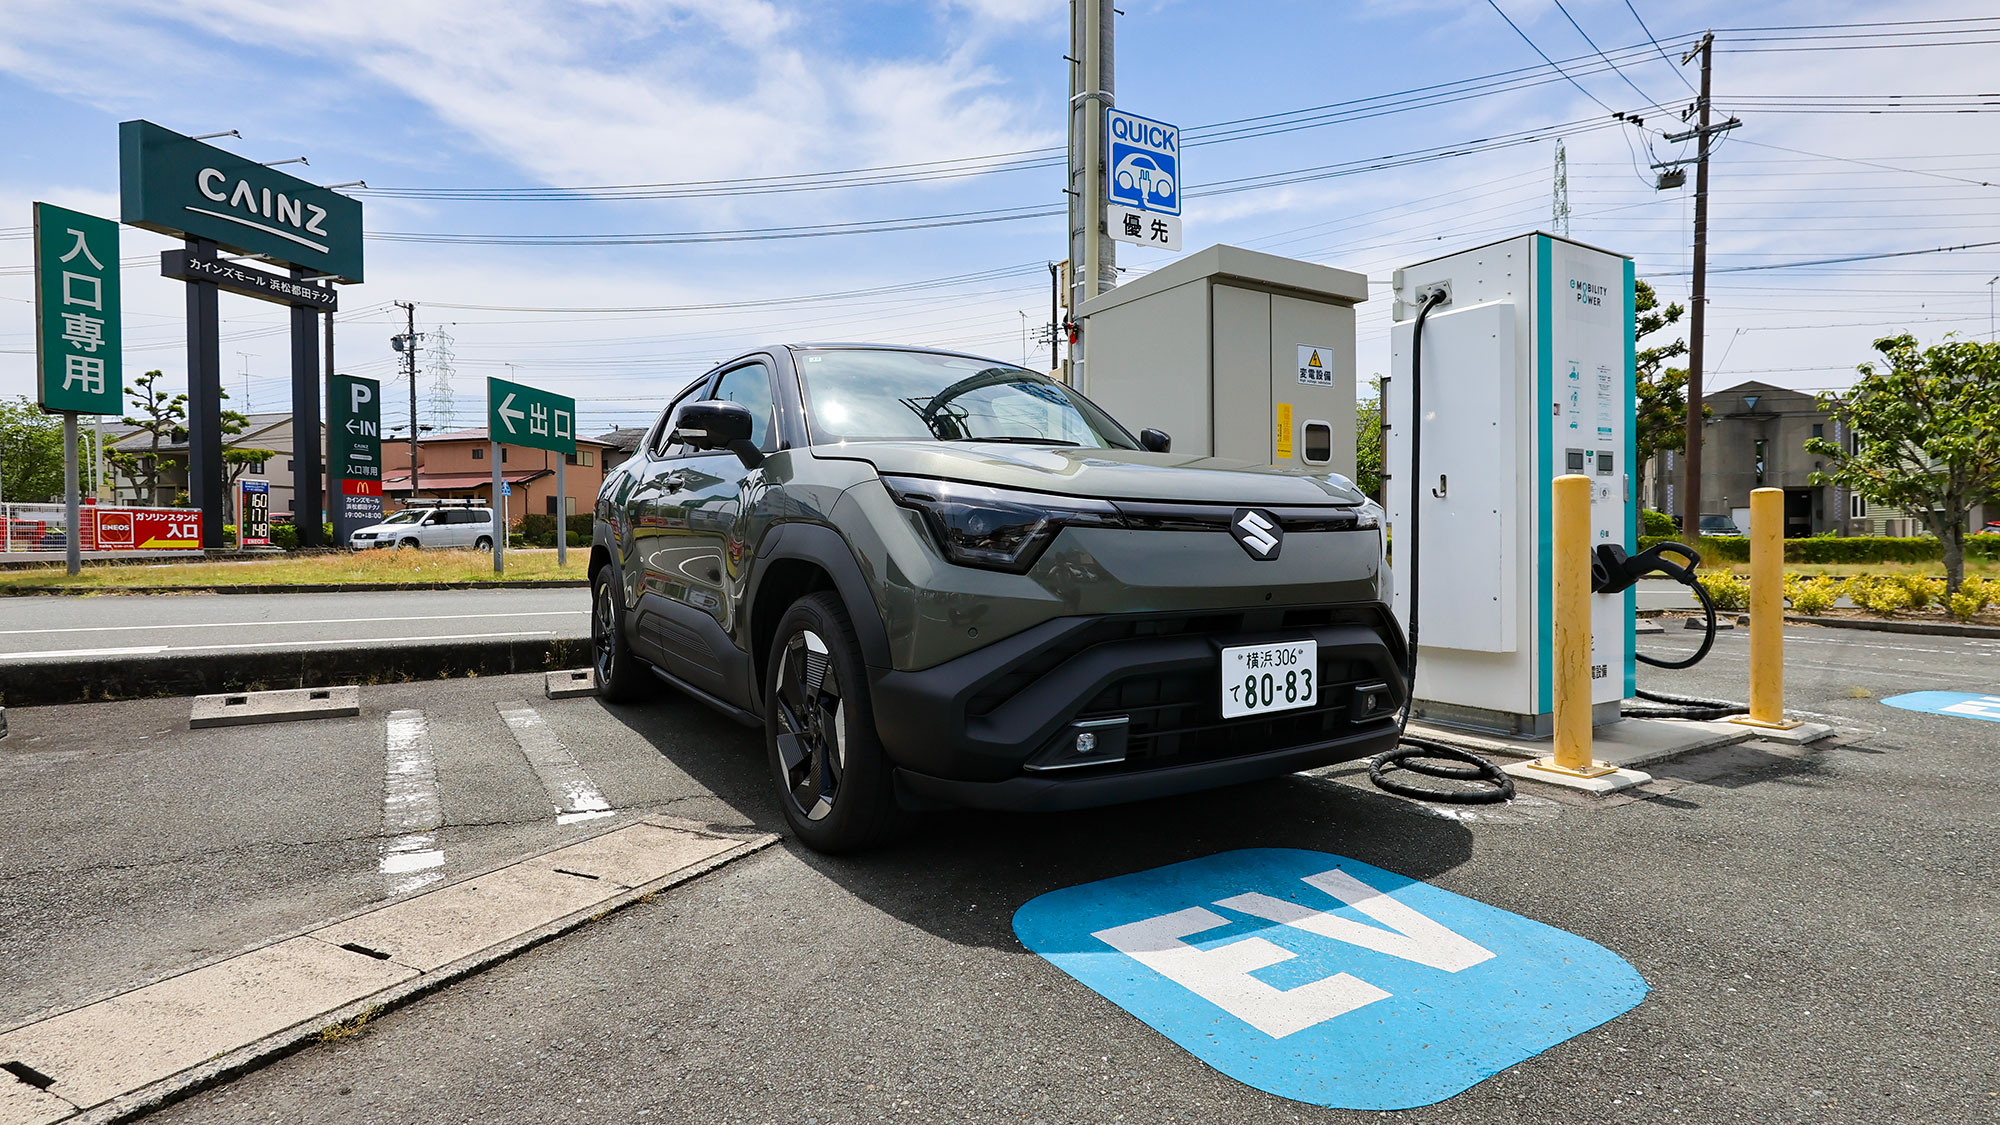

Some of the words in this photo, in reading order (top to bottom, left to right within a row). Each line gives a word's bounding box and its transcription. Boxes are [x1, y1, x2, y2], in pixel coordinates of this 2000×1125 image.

[1112, 117, 1175, 152] QUICK
[198, 168, 328, 237] CAINZ
[1123, 212, 1168, 243] 優先
[189, 258, 266, 286] カインズモール
[269, 278, 336, 304] 浜松都田テクノ
[59, 228, 105, 394] 入口専用
[1577, 293, 1601, 307] POWER
[351, 382, 372, 413] P
[360, 420, 377, 437] IN
[529, 402, 571, 440] 出口
[346, 464, 378, 477] 入口専用
[251, 493, 268, 508] 160
[346, 496, 380, 504] カインズモール
[135, 512, 198, 522] ガソリンスタンド
[251, 508, 268, 522] 171
[166, 523, 199, 539] 入口
[251, 523, 268, 537] 148
[1229, 684, 1241, 703] て
[1245, 668, 1313, 709] 80-83
[1091, 868, 1498, 1040] EV
